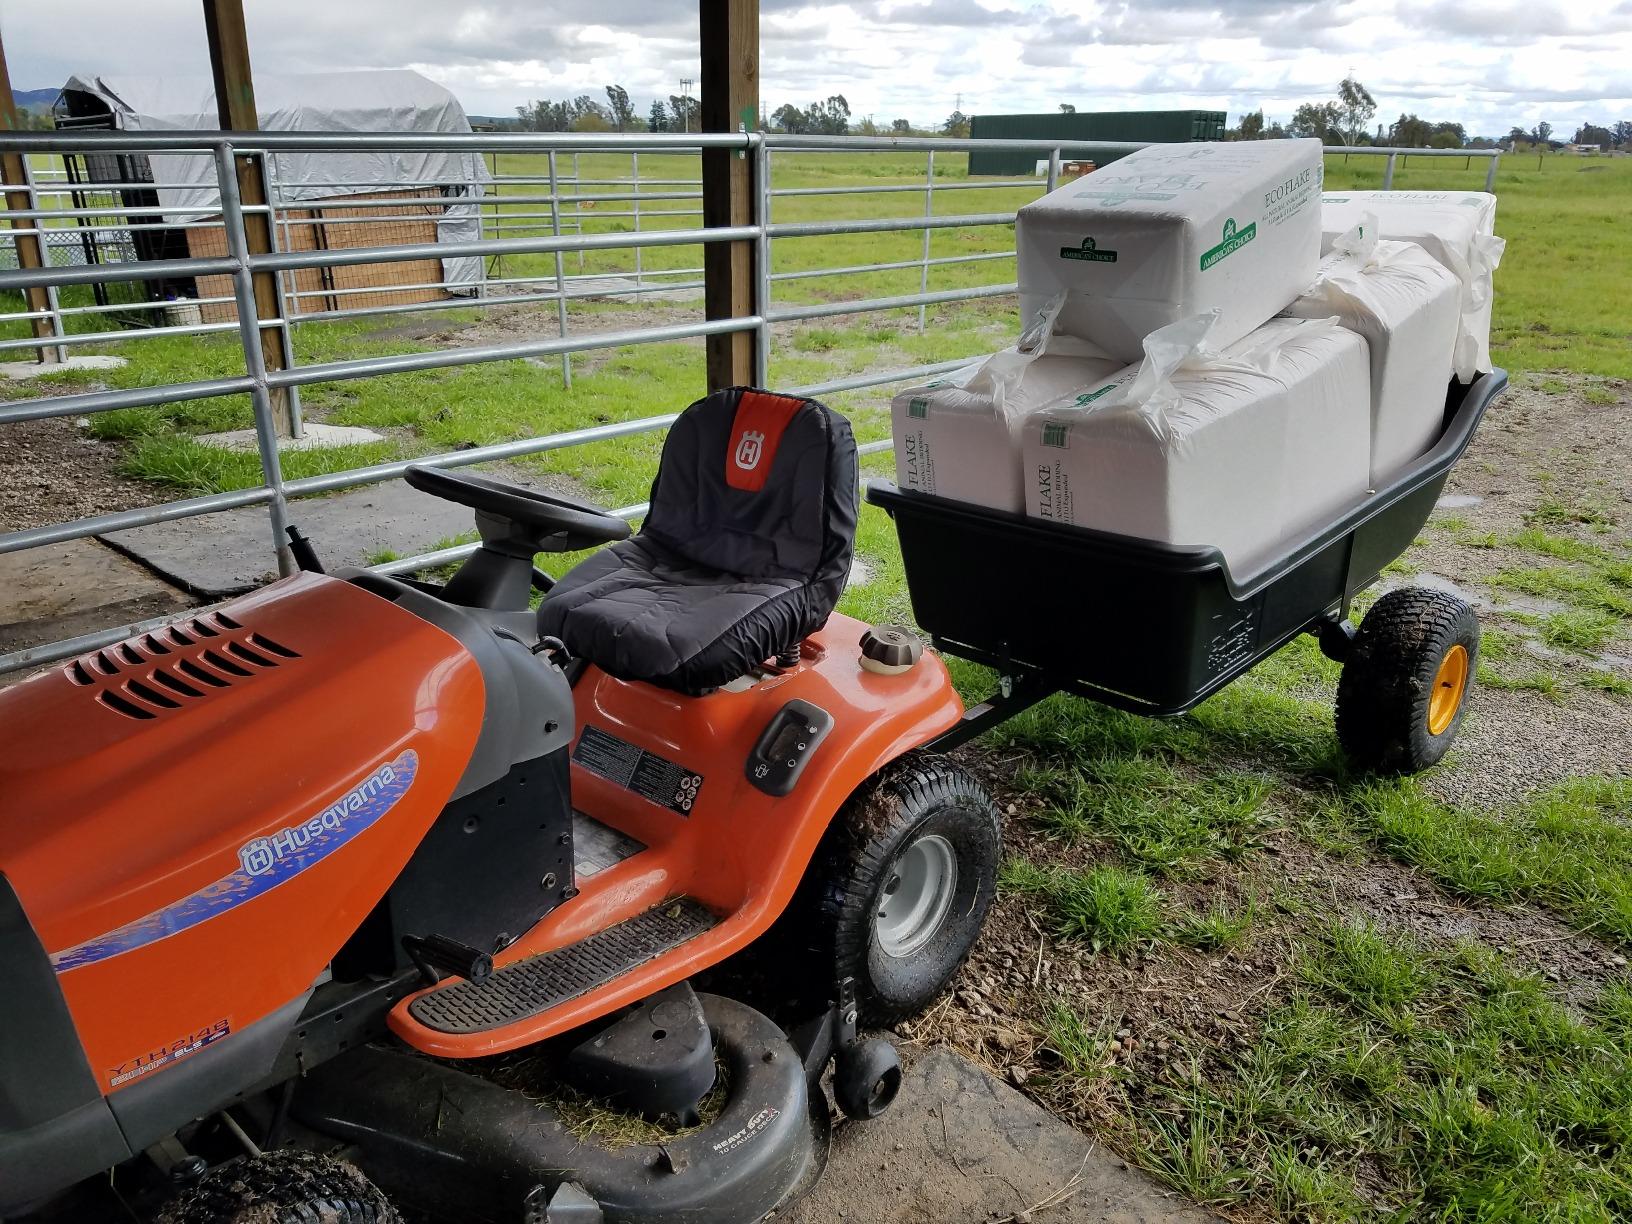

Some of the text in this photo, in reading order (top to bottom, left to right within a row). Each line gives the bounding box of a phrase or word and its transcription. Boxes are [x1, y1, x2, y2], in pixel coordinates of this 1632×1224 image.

[1264, 168, 1311, 208] ECO FLAKE
[1233, 230, 1255, 250] CHOICE
[1092, 252, 1115, 262] CHOICE
[905, 434, 918, 486] FLAKE
[1038, 464, 1052, 518] FLAKE
[1062, 474, 1070, 506] Expanded
[270, 763, 397, 860] Husqvarna
[712, 1128, 747, 1151] HEAVY
[730, 1130, 757, 1149] GAUGE
